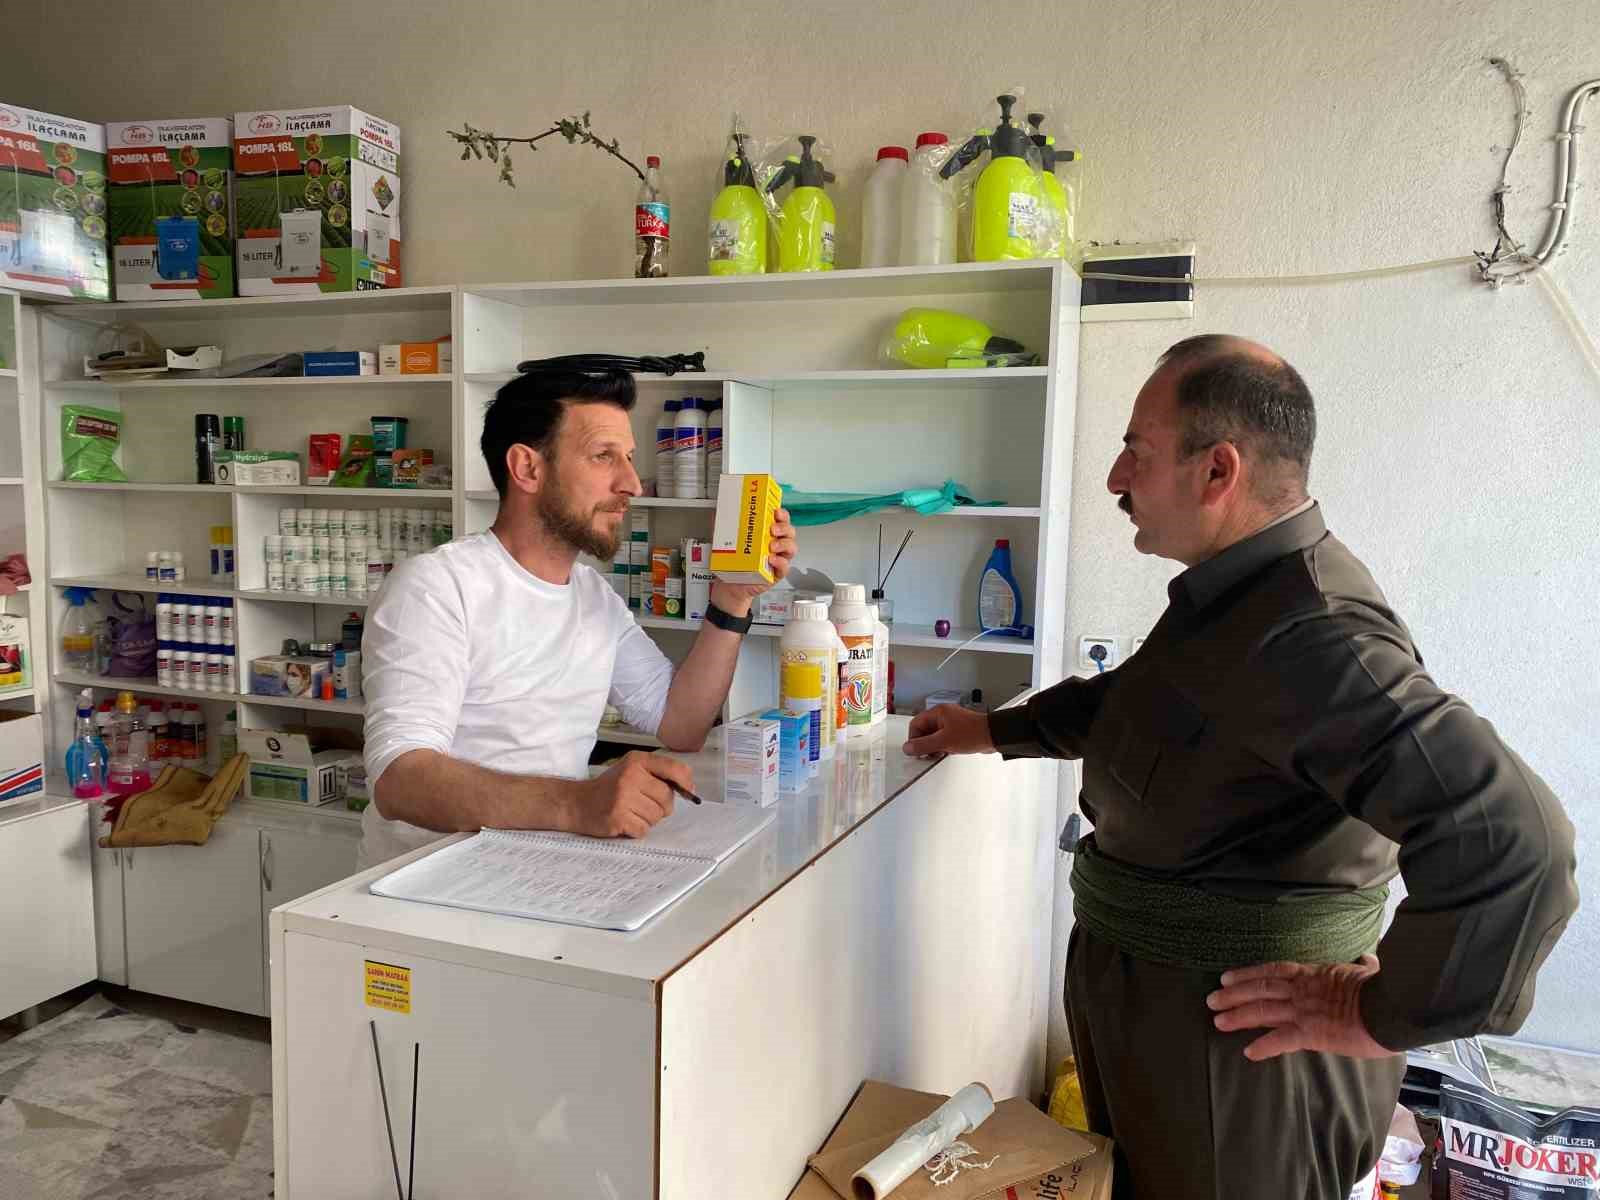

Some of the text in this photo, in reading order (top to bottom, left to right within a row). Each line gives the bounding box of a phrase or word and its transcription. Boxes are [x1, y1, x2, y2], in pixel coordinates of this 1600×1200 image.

[239, 142, 275, 155] POMPA
[112, 153, 150, 165] POMPA
[743, 495, 758, 555] Primamycin
